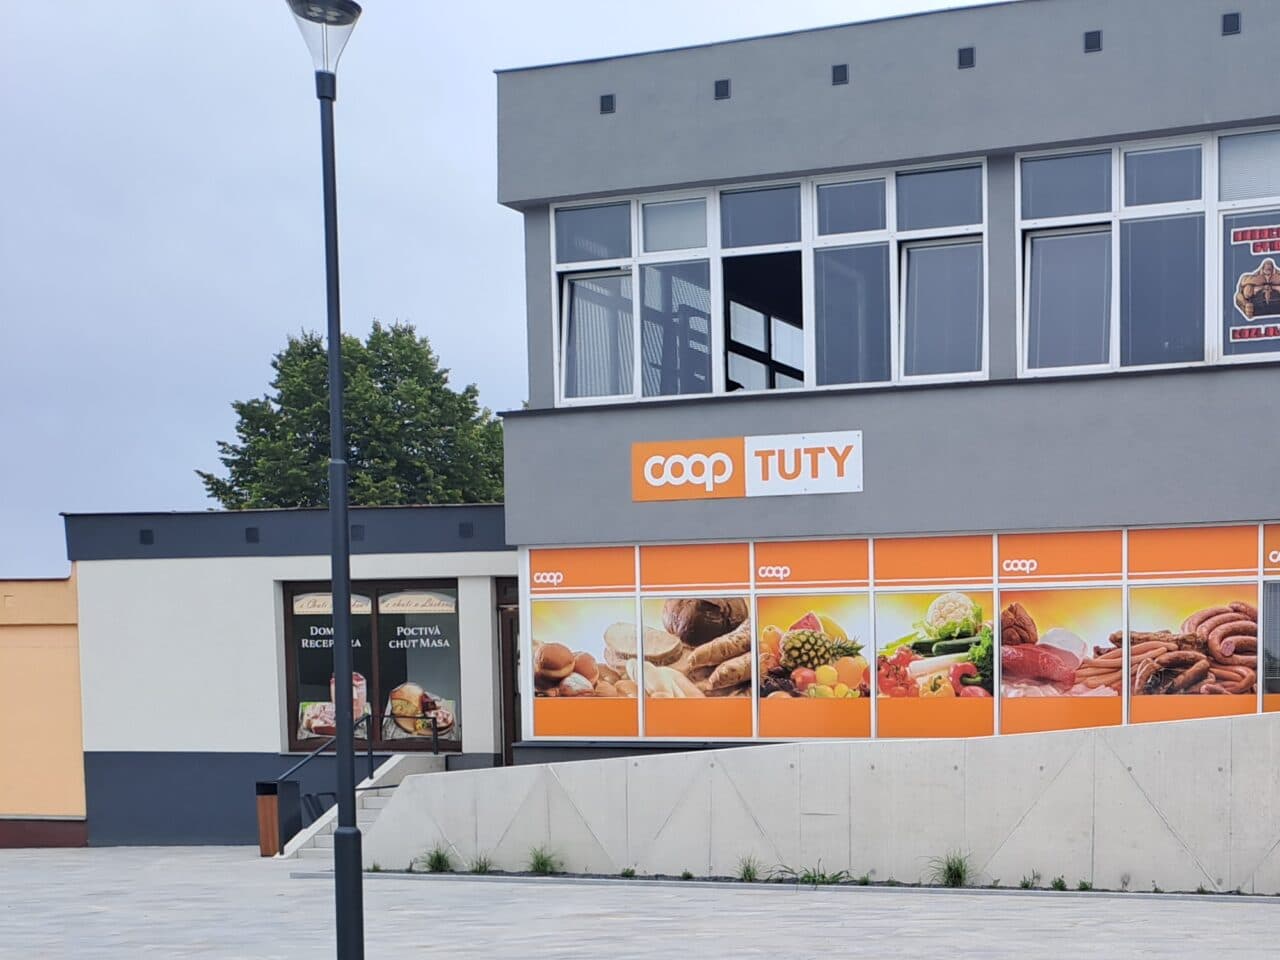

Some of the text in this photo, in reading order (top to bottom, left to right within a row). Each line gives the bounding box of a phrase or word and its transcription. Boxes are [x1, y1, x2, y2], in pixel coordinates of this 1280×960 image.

[644, 445, 854, 492] coop TUTY
[758, 565, 790, 580] coop
[1002, 559, 1037, 573] coop
[533, 571, 563, 585] coop
